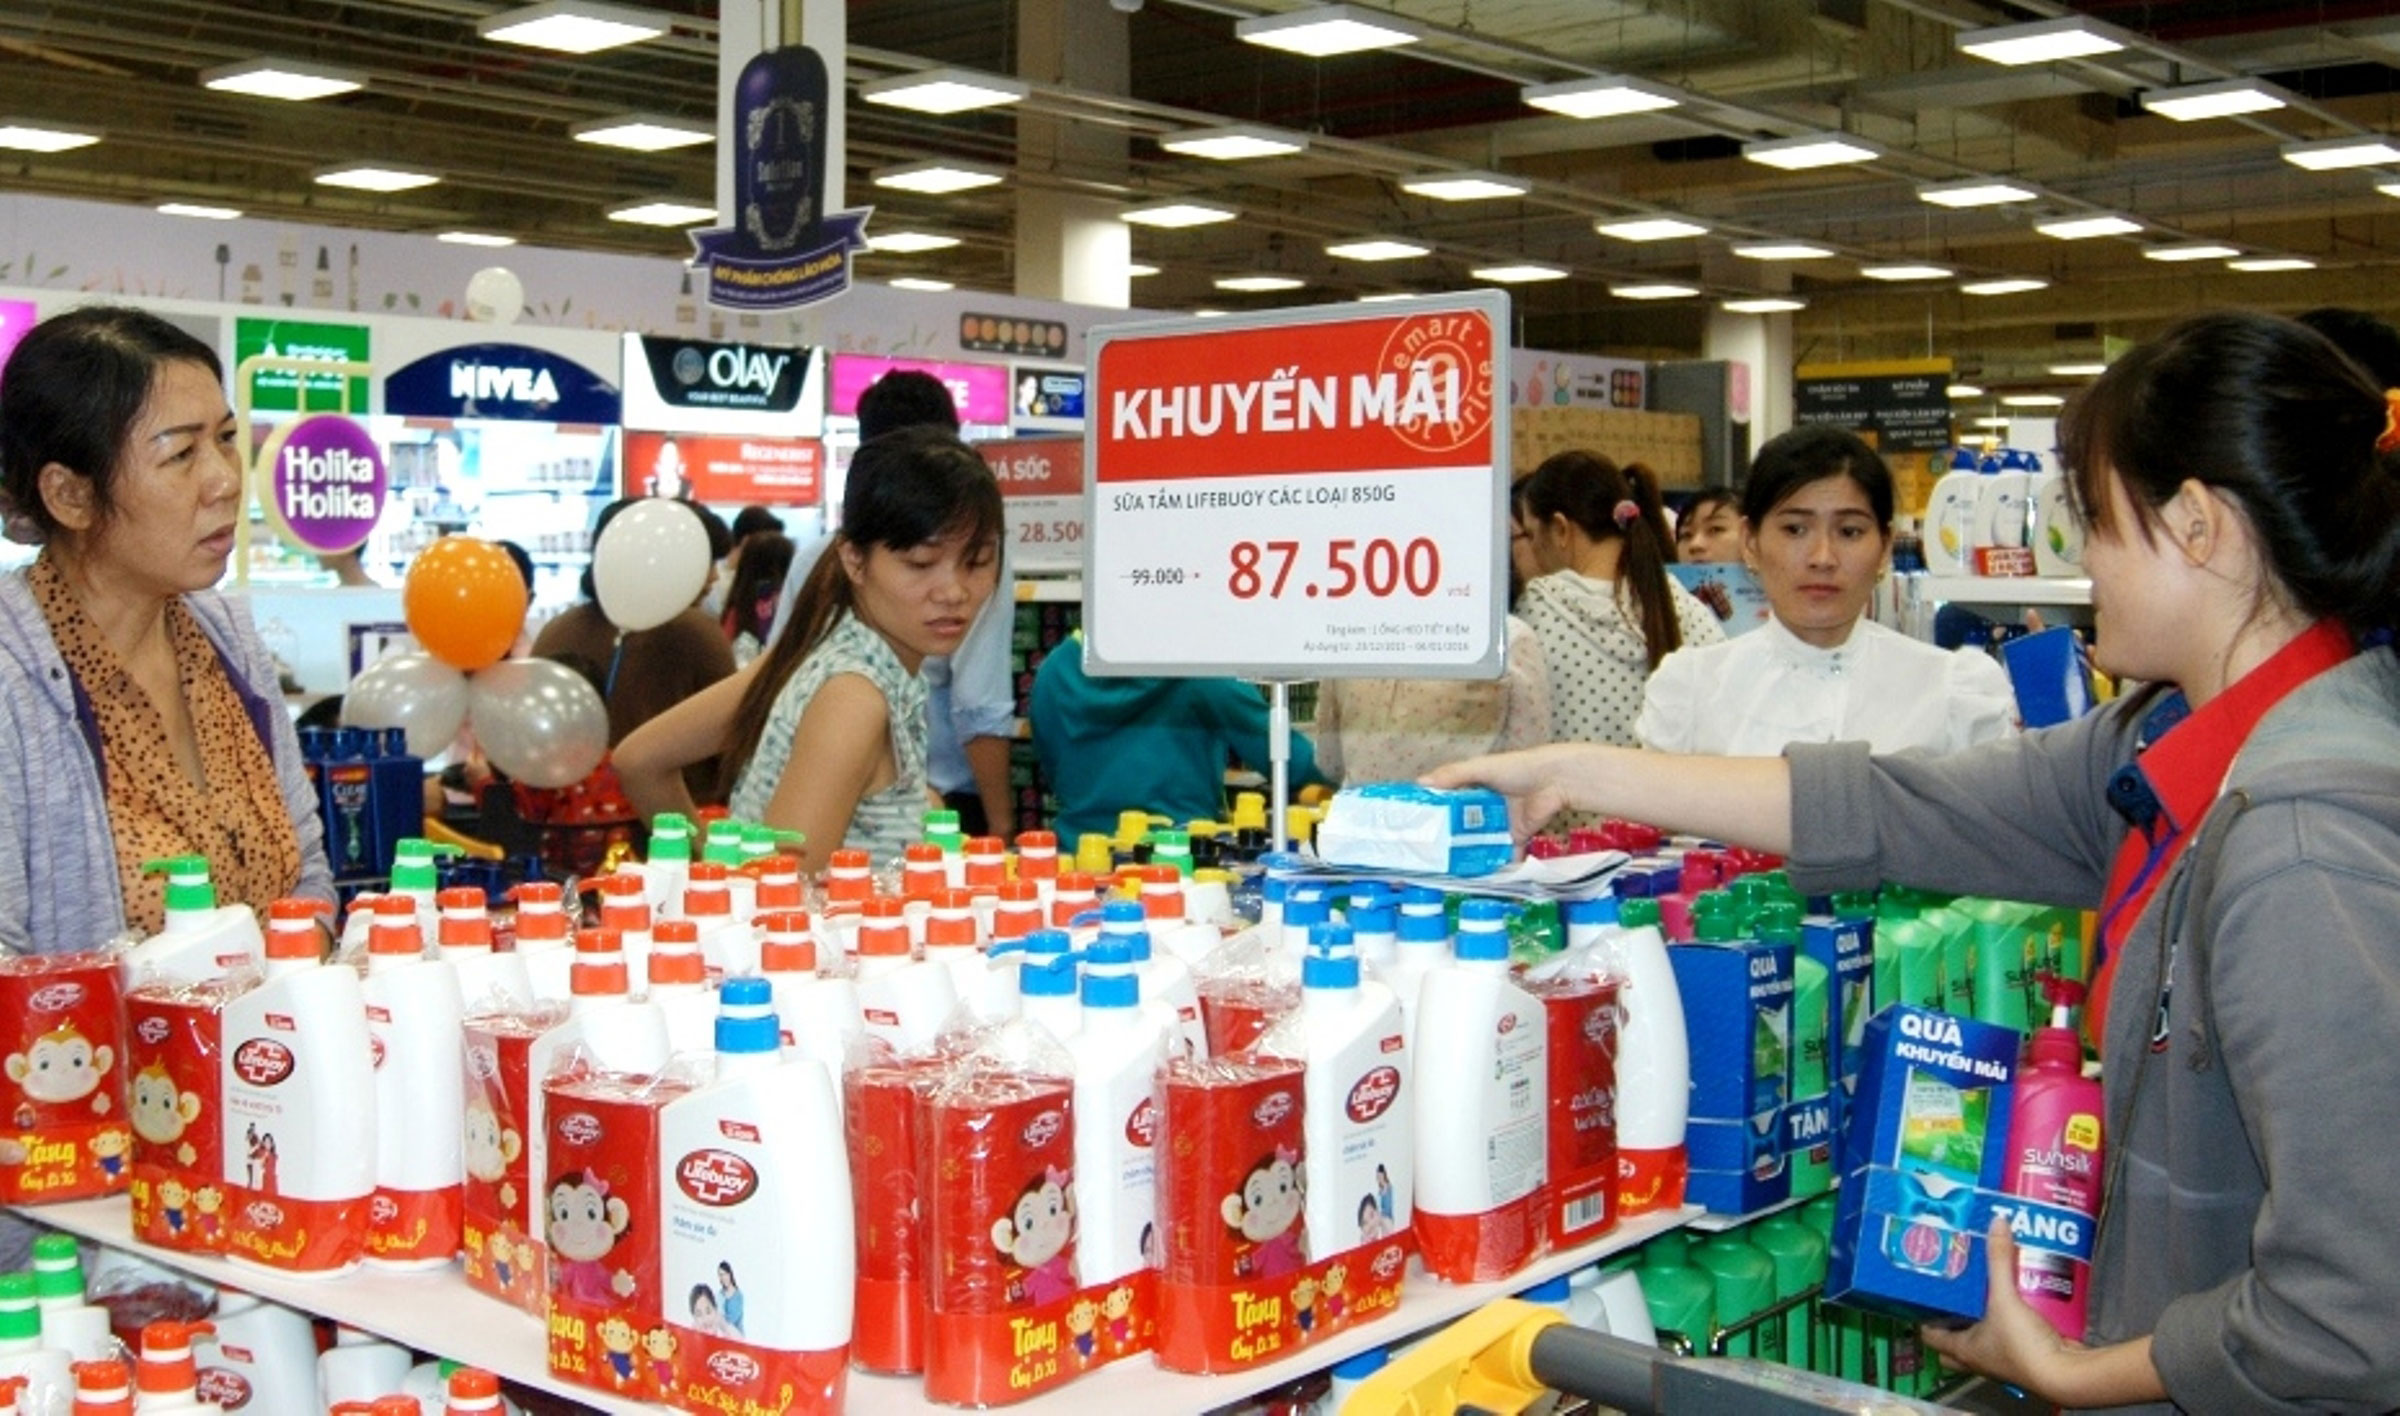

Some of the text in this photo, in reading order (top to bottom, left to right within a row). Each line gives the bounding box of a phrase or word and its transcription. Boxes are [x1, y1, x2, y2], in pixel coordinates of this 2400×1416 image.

[1393, 317, 1473, 371] emart
[450, 362, 560, 402] NIVEA
[1111, 359, 1461, 441] KHUYẾN MÃI
[284, 445, 375, 483] Holika
[285, 482, 376, 519] Holika
[1186, 488, 1265, 509] LIFEBUOY
[1268, 485, 1302, 506] CÁC
[1351, 484, 1396, 504] 850G
[1227, 536, 1441, 600] 87.500
[1900, 1012, 1964, 1048] QUÀ
[1896, 1040, 2008, 1082] KHUYẾN MÃI
[1789, 1105, 1830, 1141] TẶN
[683, 1160, 750, 1192] Lifebuoy
[1990, 1203, 2081, 1247] TẶNG
[550, 1292, 586, 1352] ặng
[1231, 1291, 1282, 1337] Tặng
[1009, 1316, 1058, 1365] Tặng
